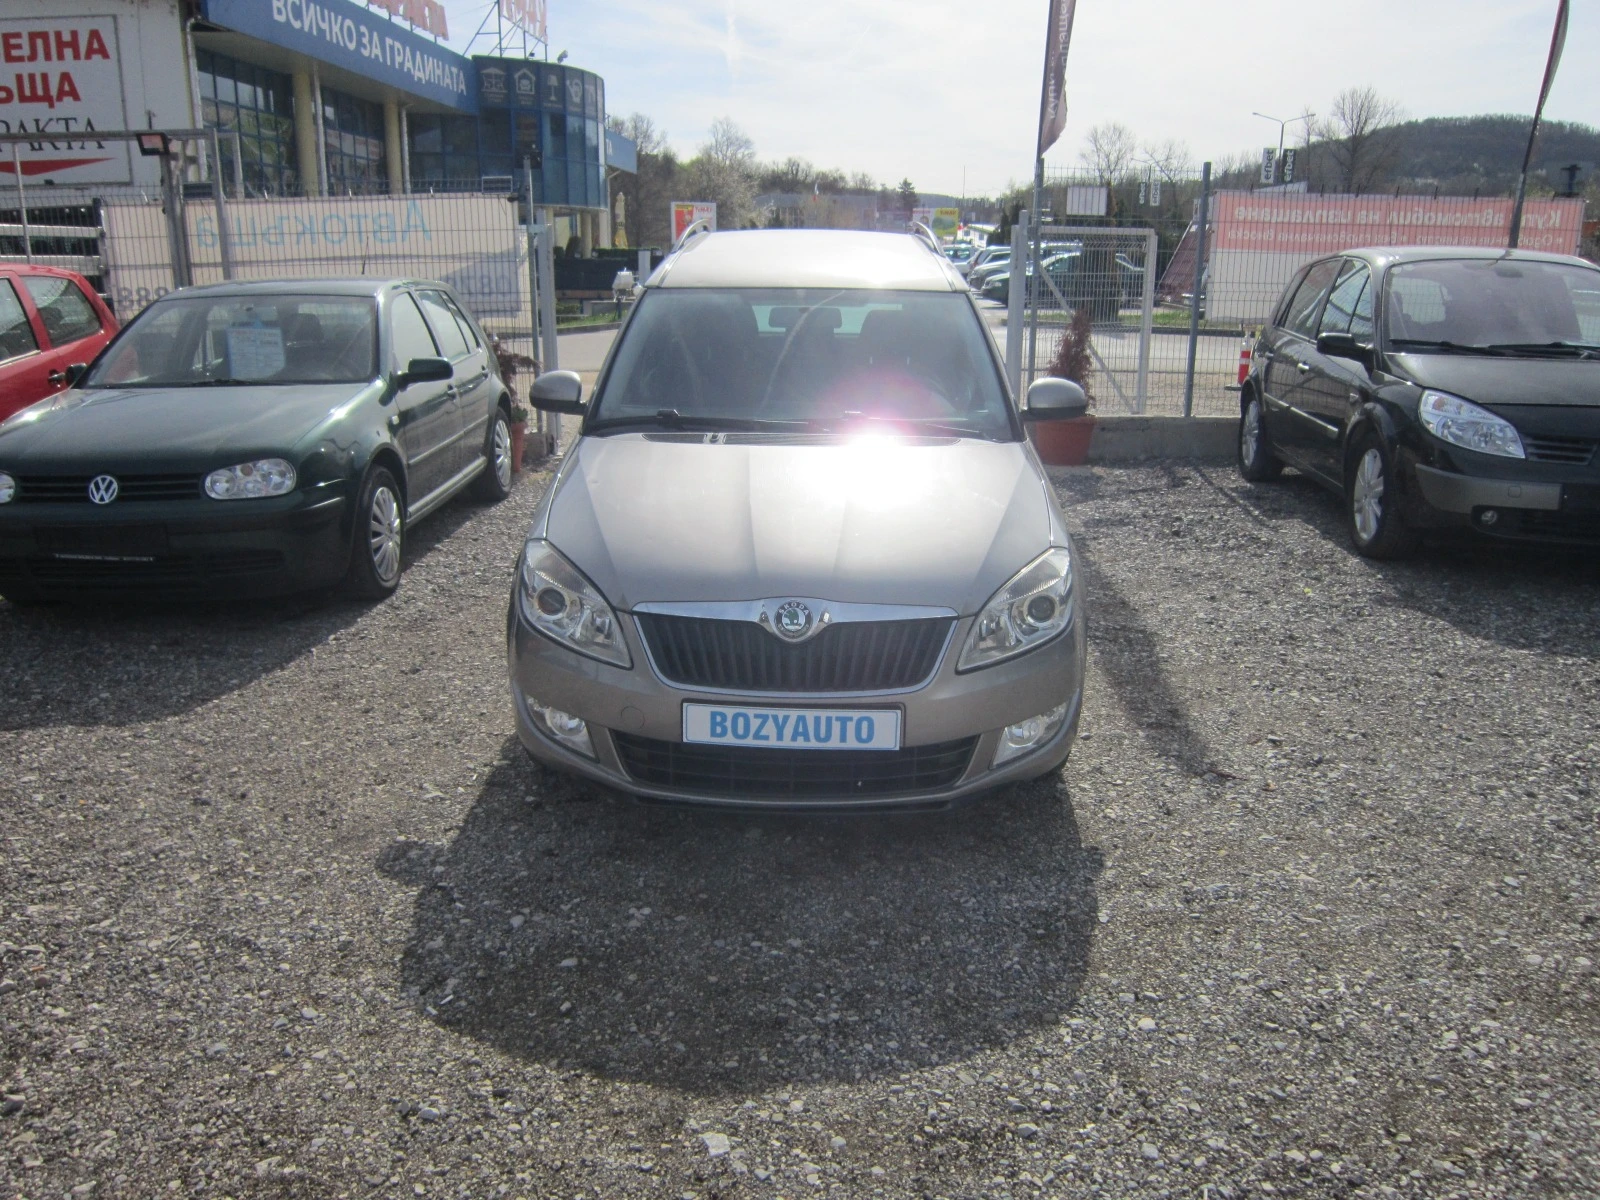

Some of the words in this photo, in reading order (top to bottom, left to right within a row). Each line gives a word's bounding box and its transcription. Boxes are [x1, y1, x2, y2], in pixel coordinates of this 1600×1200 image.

[1, 29, 111, 63] ЕЛНА
[272, 0, 357, 51] ВСИЧКО
[359, 25, 383, 63] ЗА
[385, 37, 467, 96] ГРАДИНАТА
[1264, 149, 1274, 181] efbet
[1284, 149, 1295, 182] efbet
[709, 710, 875, 744] BOZYAUTO
